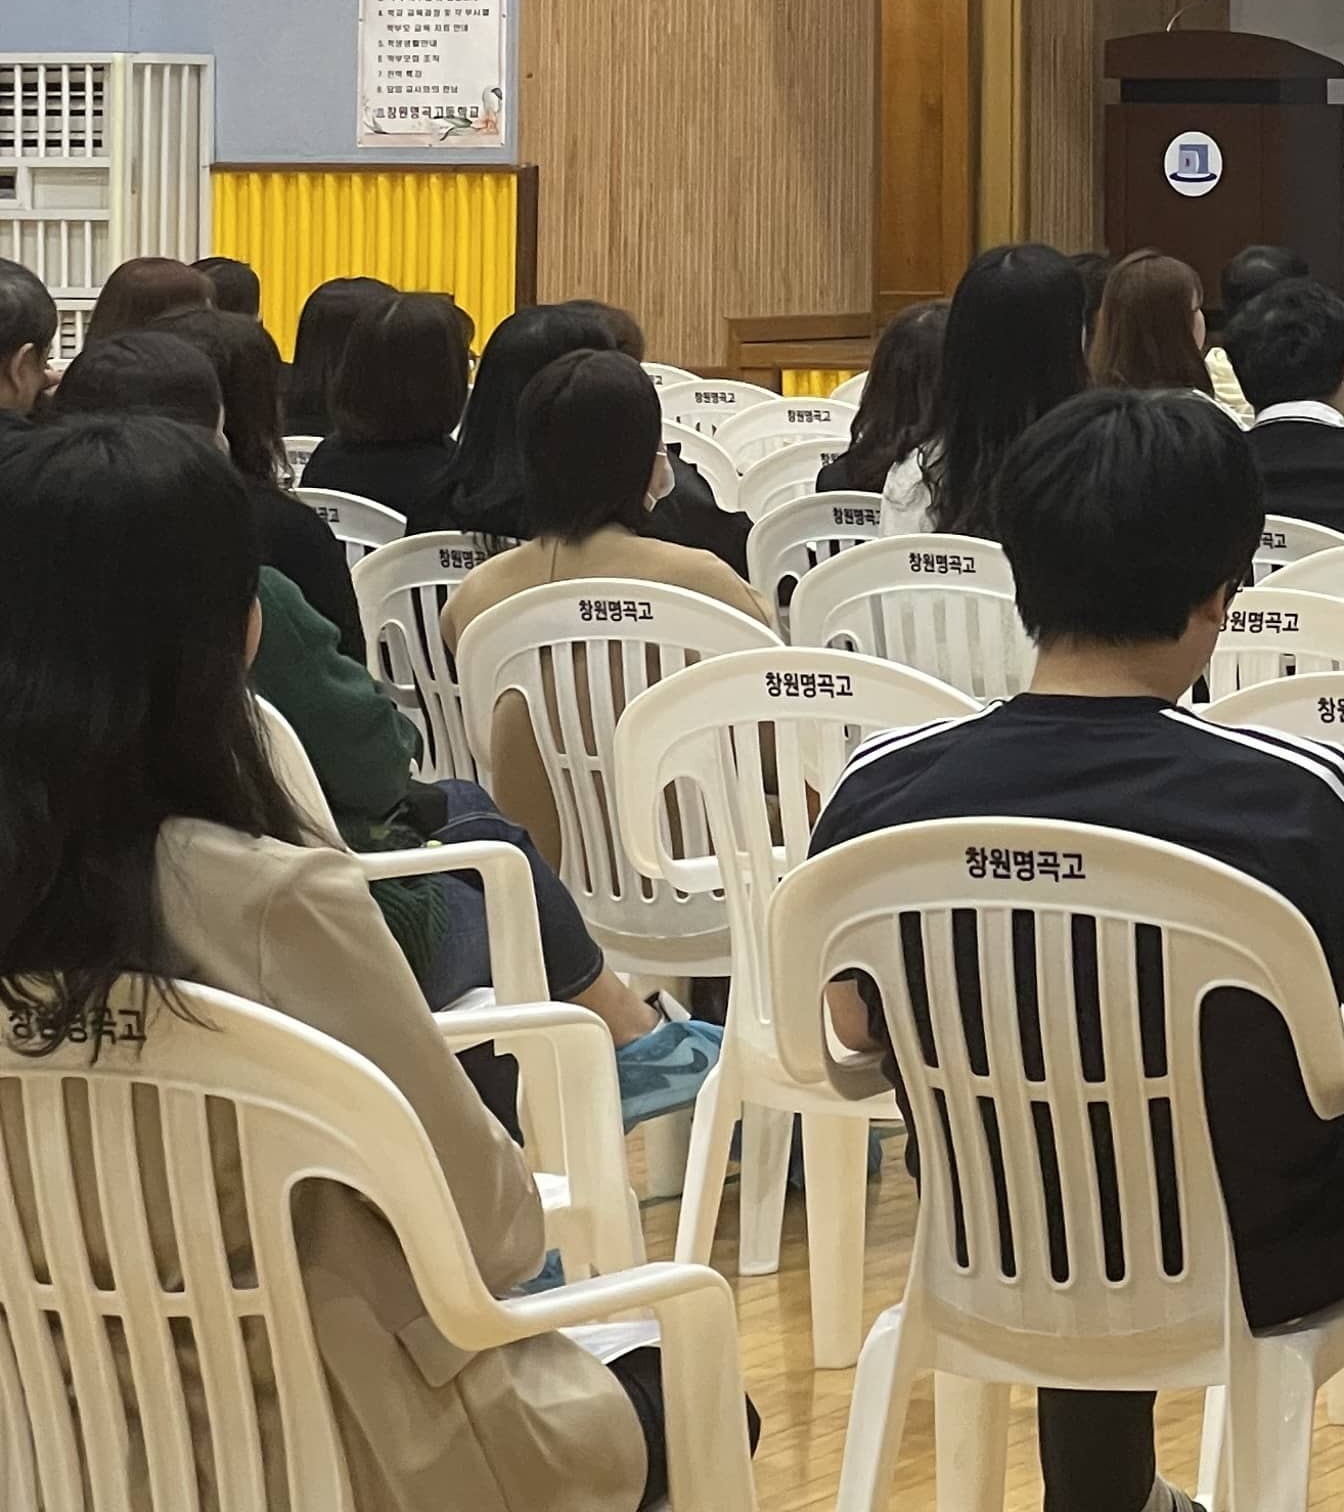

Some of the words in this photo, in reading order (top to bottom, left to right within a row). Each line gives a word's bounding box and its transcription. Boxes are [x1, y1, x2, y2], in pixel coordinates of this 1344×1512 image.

[787, 409, 832, 424] 창원명곡고
[908, 552, 977, 575] 창원명곡고
[578, 599, 654, 623] 창원명곡고
[765, 671, 854, 699] 창원명곡고
[964, 845, 1087, 884] 창원명곡고
